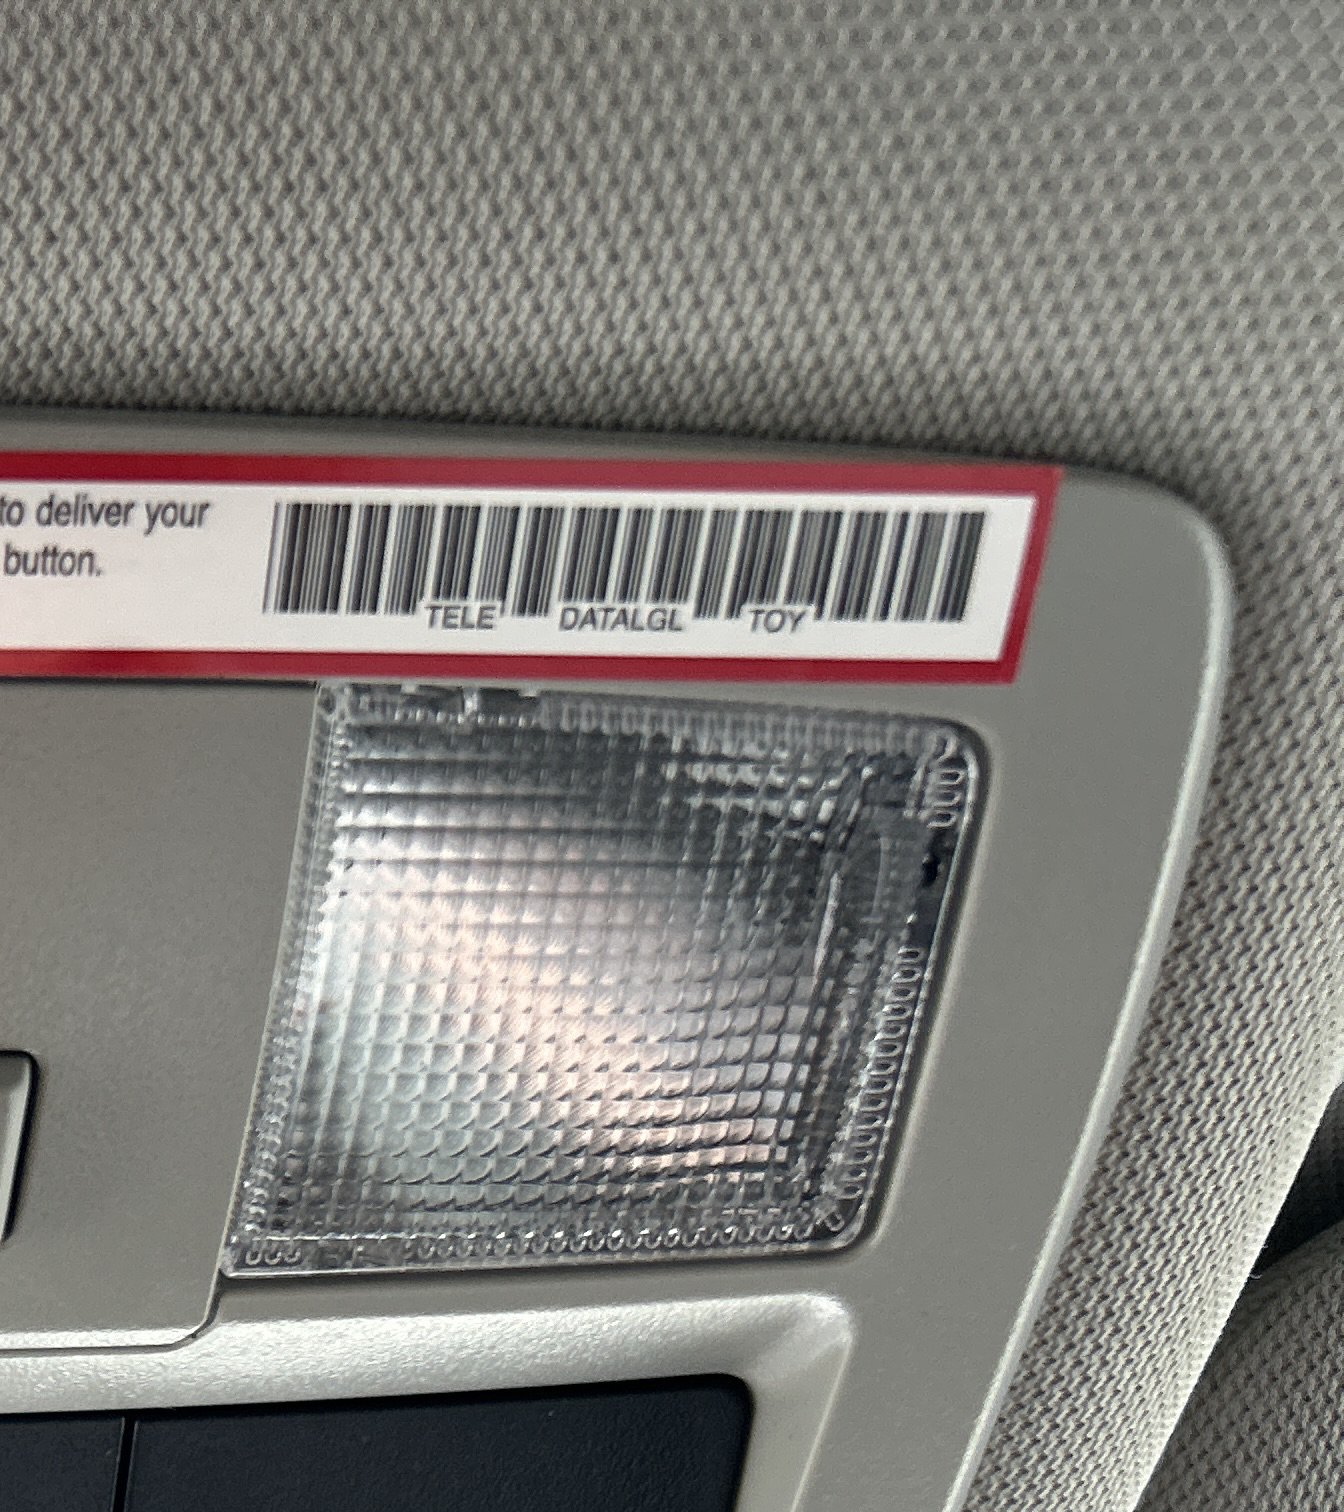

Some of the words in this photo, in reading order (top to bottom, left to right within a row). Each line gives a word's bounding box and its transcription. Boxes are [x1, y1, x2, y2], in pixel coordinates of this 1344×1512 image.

[35, 493, 135, 527] deliver
[144, 500, 211, 536] your
[3, 542, 102, 577] button.
[425, 603, 497, 631] TELE
[559, 606, 683, 632] DATALGL
[750, 604, 807, 634] TOY
